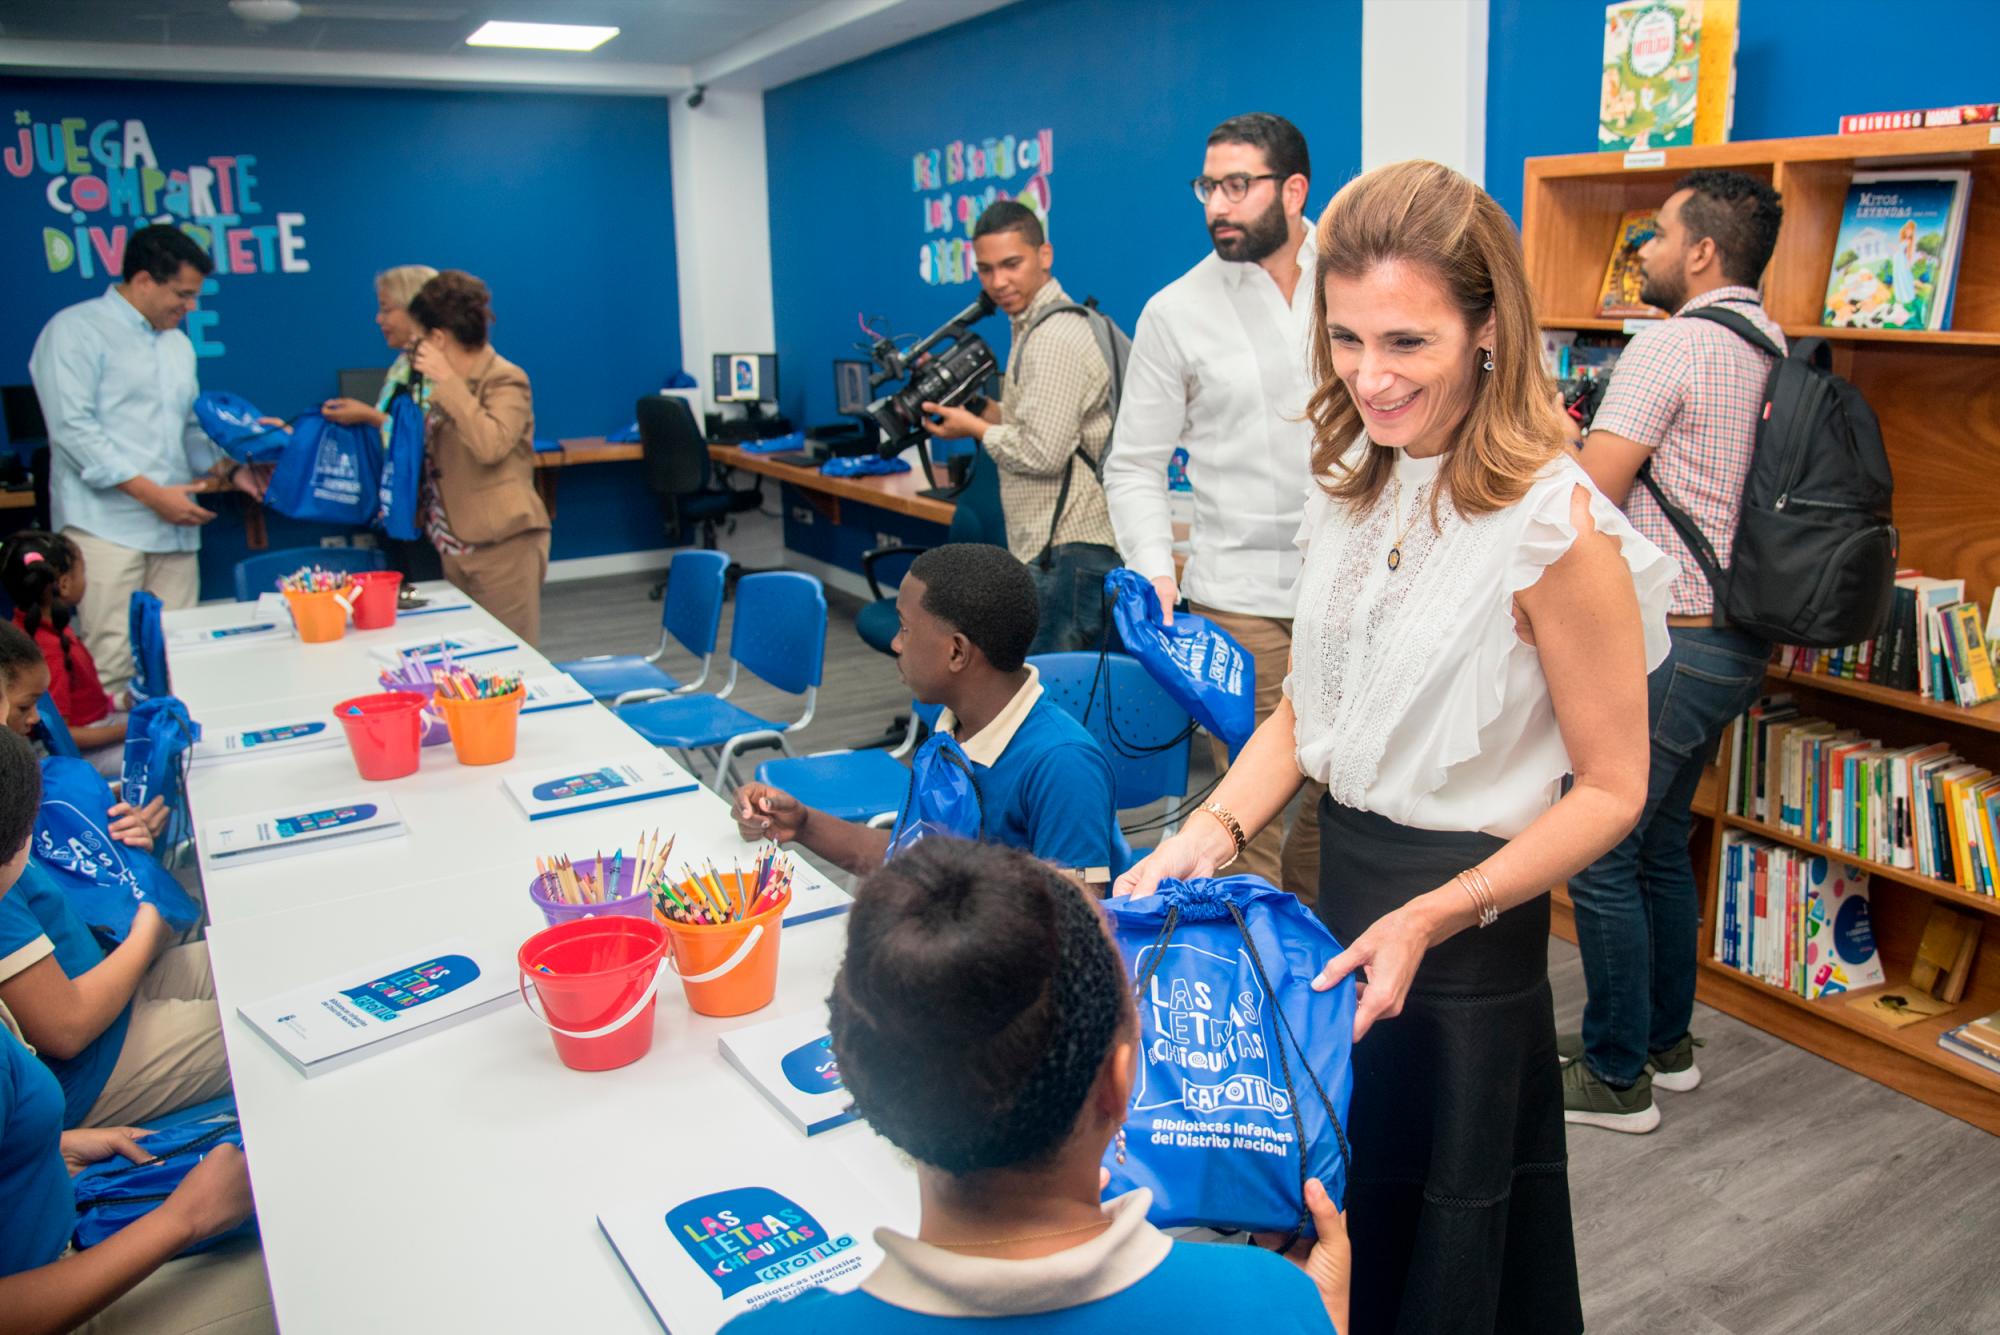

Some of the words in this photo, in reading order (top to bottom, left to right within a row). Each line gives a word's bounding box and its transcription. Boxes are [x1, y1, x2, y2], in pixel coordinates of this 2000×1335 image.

[1848, 112, 1922, 132] UNIVERSO
[4, 110, 158, 178] JUEGA
[46, 155, 262, 217] COMPARTE
[1858, 192, 1898, 207] MITOS
[1855, 206, 1912, 219] LEYENDAS
[43, 212, 310, 279] DIVTETE
[1150, 974, 1212, 1011] LAS
[1152, 991, 1259, 1047] LETRAS
[1150, 1031, 1264, 1072] CHIQUITAS
[1188, 1078, 1288, 1113] CAPOTILLO
[1151, 1131, 1173, 1145] del
[1176, 1134, 1230, 1149] Distrito
[1152, 1118, 1231, 1134] Bibliotecas
[683, 1210, 741, 1243] LAS
[700, 1208, 803, 1260] LETRAS
[714, 1226, 815, 1274] CHIQUITAS
[762, 1236, 853, 1281] CAPOTILLO
[746, 1277, 808, 1304] Bibliotecas
[810, 1256, 862, 1280] Infantiles
[815, 1262, 862, 1286] Nacional
